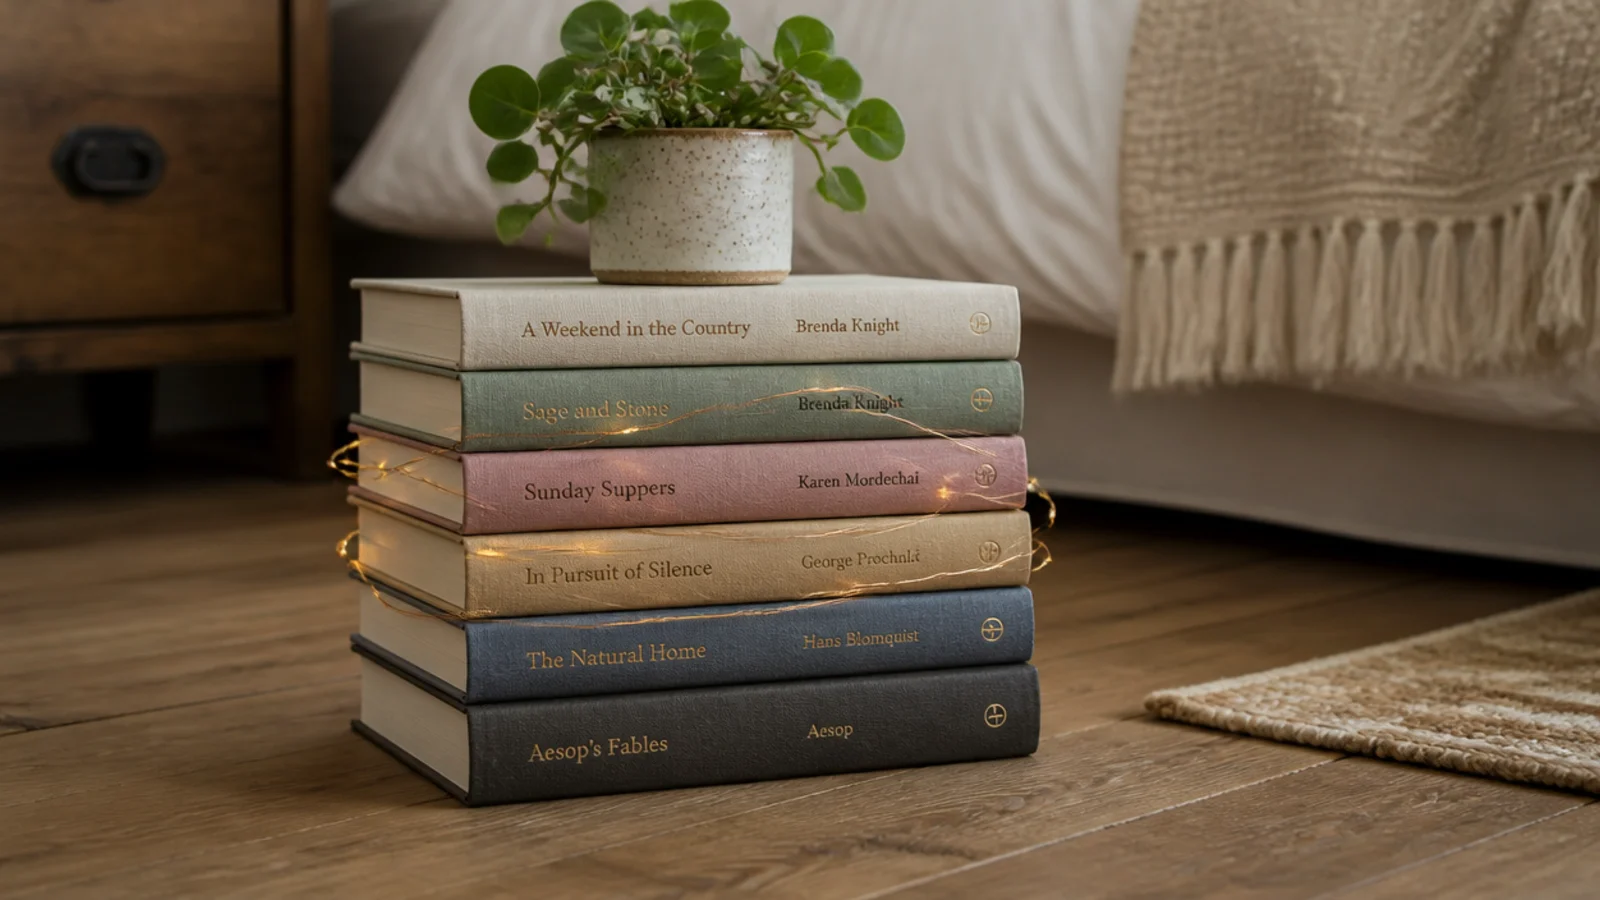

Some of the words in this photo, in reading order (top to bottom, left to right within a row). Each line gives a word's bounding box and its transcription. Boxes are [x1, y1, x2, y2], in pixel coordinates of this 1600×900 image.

[522, 322, 535, 336] A
[541, 321, 620, 336] Weekend
[627, 321, 643, 336] in
[648, 320, 676, 335] the
[681, 320, 751, 338] Country
[796, 319, 847, 333] Brenda
[851, 318, 900, 334] Knight
[523, 401, 569, 424] Sage
[575, 401, 612, 419] and
[616, 400, 669, 417] Stone
[798, 396, 851, 411] Brenda
[853, 395, 904, 413] Knight
[798, 473, 840, 489] Karen
[845, 471, 919, 487] Mordechai
[524, 483, 595, 504] Sunday
[601, 480, 675, 502] Suppers
[801, 552, 853, 571] George
[525, 566, 545, 585] In
[551, 564, 619, 584] Pursuit
[624, 562, 644, 580] of
[648, 561, 712, 579] Silence
[803, 634, 841, 650] Hans
[846, 629, 920, 649] Blomquist
[527, 651, 565, 670] The
[570, 645, 644, 667] Natural
[650, 643, 706, 662] Home
[807, 723, 853, 740] Aesop
[528, 740, 602, 763] Aesop's
[608, 736, 668, 756] Fables
